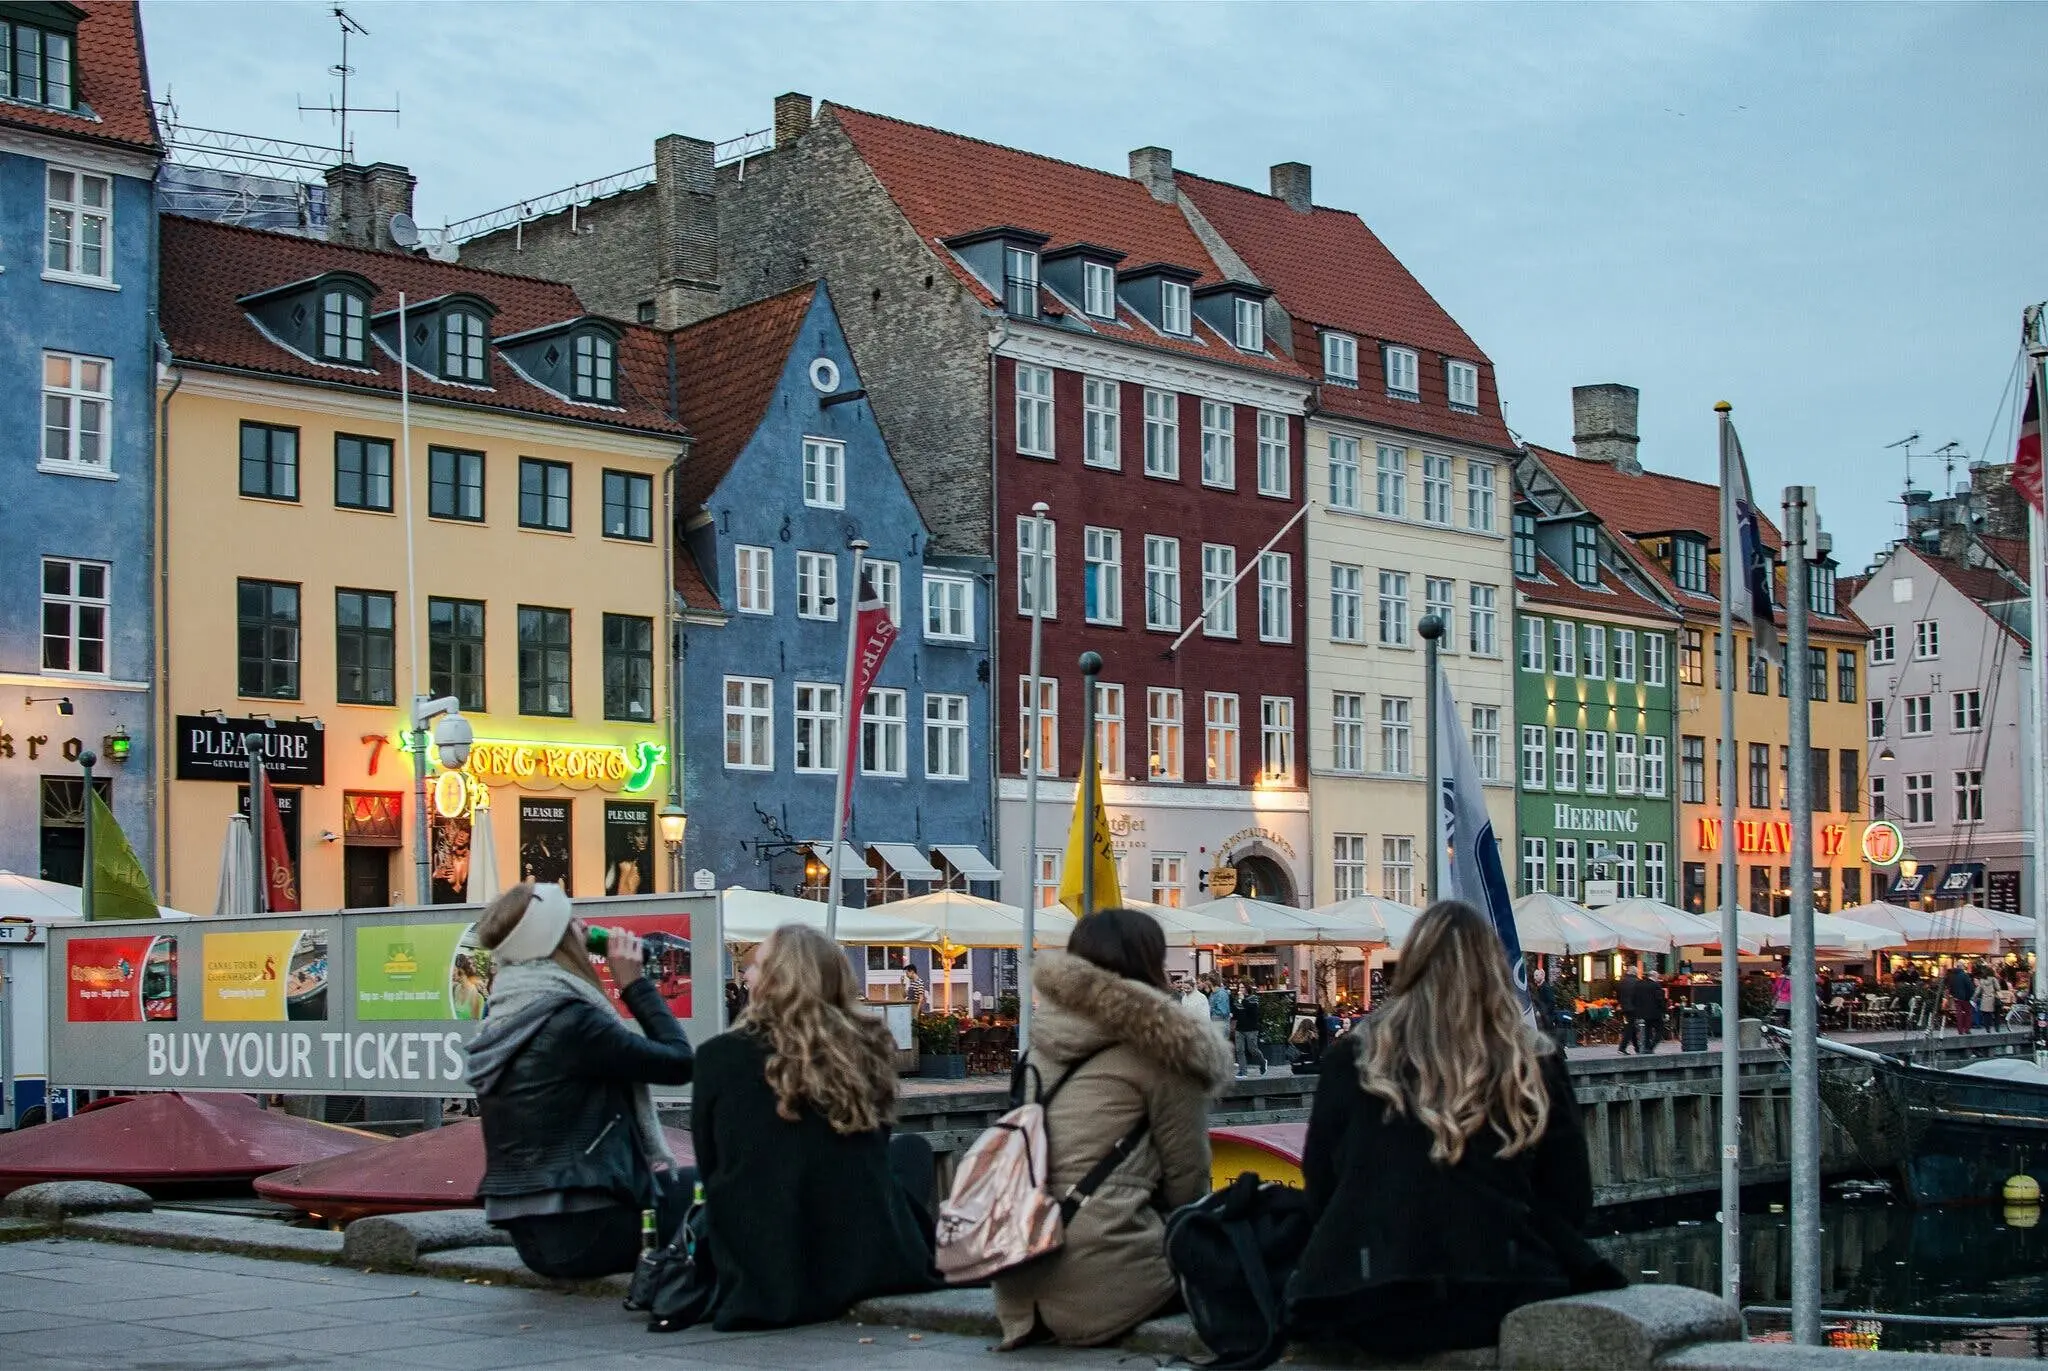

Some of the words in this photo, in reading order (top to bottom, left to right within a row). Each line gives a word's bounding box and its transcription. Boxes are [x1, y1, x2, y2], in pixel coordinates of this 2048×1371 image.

[191, 729, 308, 759] PLEAURE
[265, 762, 287, 770] CLUB
[464, 744, 537, 777] ONG
[523, 806, 565, 818] PLEASURE
[607, 810, 648, 821] PLEASURE
[1554, 803, 1639, 833] HEERING
[1699, 818, 1793, 853] NHAV
[1824, 824, 1848, 856] 17
[1867, 830, 1893, 859] 17
[208, 961, 232, 970] CANAL
[233, 960, 257, 969] TOURS
[149, 1032, 211, 1078] BUY
[219, 1032, 313, 1079] YOUR
[321, 1032, 464, 1081] TICKETS
